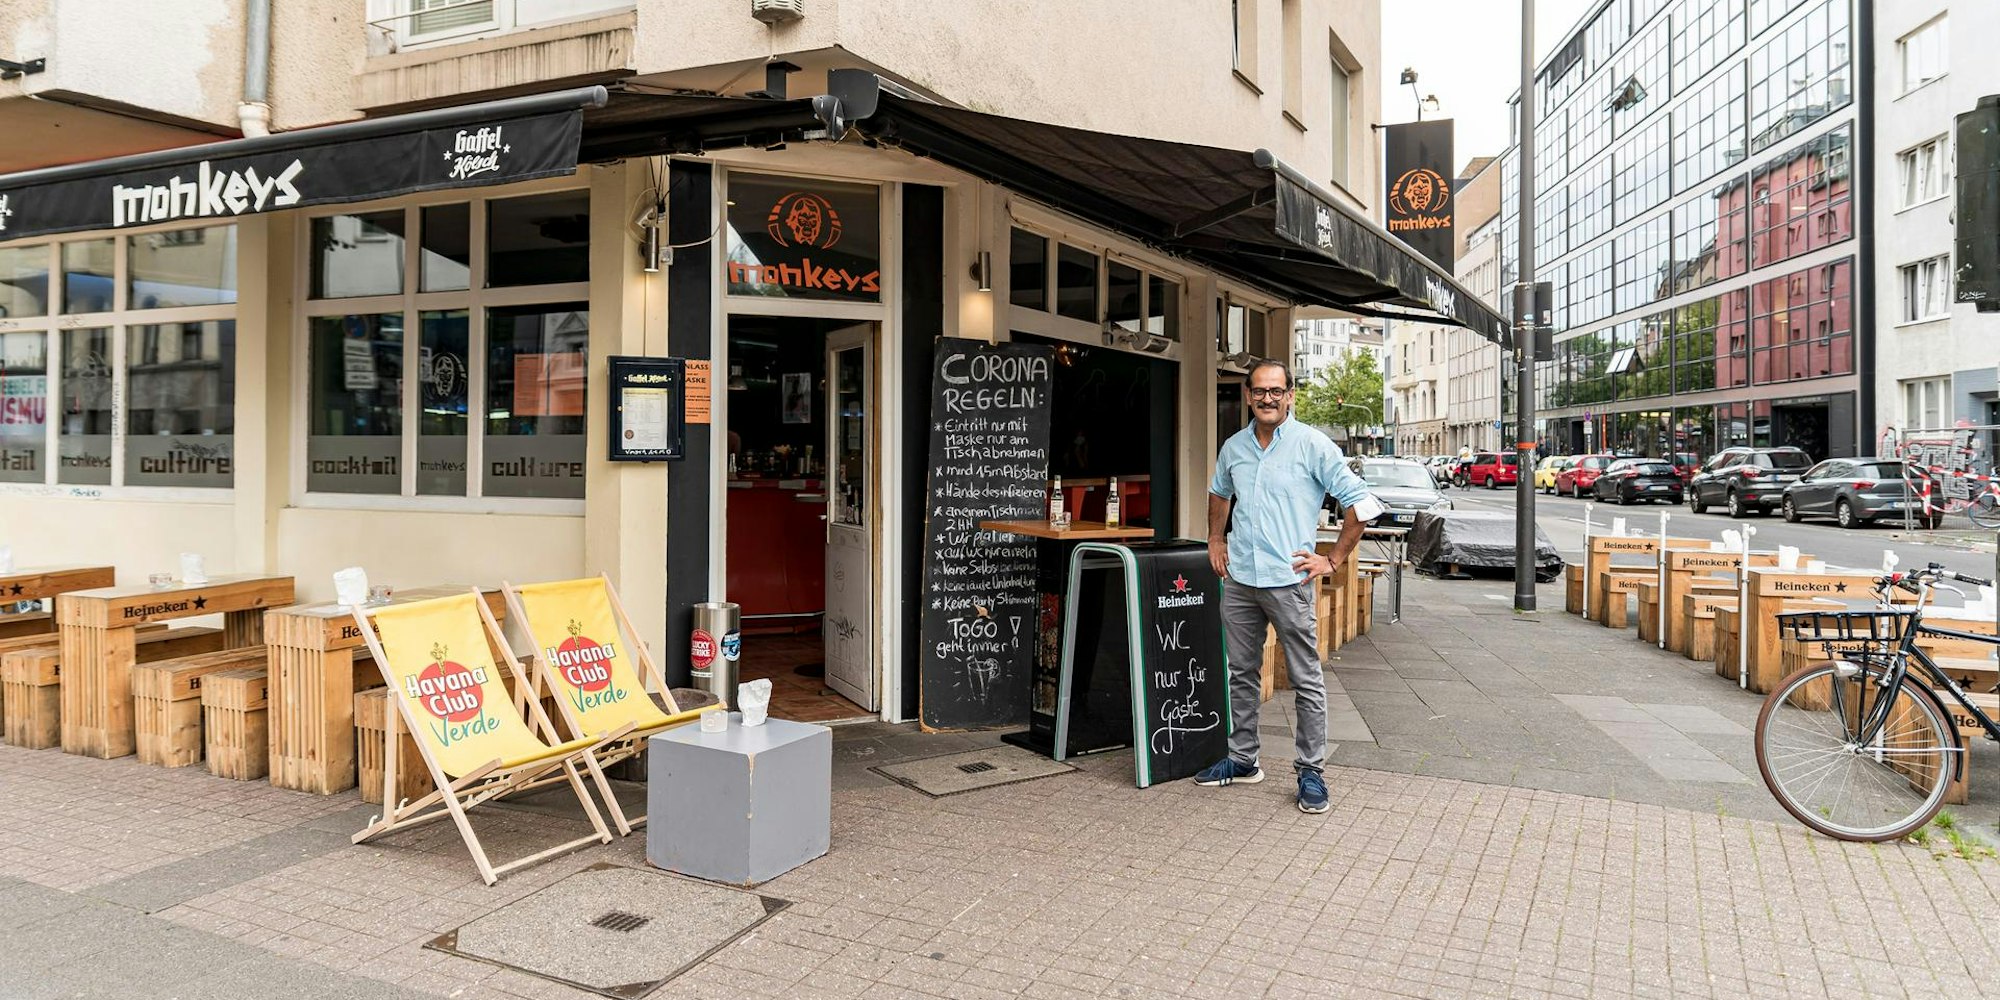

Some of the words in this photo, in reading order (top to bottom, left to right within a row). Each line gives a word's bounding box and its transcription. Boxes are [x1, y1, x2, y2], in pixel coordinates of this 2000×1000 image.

[454, 126, 502, 153] Gaffel
[449, 150, 500, 180] Kölsch
[113, 158, 303, 227] monkeys
[1389, 213, 1451, 231] monkeys
[729, 258, 880, 293] monkeys
[941, 353, 1048, 384] CORONA
[942, 386, 1044, 414] REGELN:
[945, 417, 987, 432] Eintritt
[991, 421, 1005, 431] nur
[1007, 416, 1028, 432] mit
[945, 433, 984, 446] Maske
[987, 435, 1007, 444] nur
[1009, 436, 1029, 445] am
[0, 451, 36, 471] tail
[140, 450, 230, 473] culture
[982, 446, 1045, 459] abnehmen
[312, 456, 397, 475] cocktail
[421, 457, 466, 472] monkeys
[492, 457, 584, 477] culture
[946, 479, 981, 499] Hände
[948, 531, 972, 545] Wir
[1604, 542, 1643, 550] Heineken
[1683, 557, 1728, 567] Heineken
[1774, 581, 1831, 592] Heineken
[124, 600, 189, 618] Heineken
[943, 595, 971, 611] Keine
[1158, 593, 1204, 609] Heineken
[1156, 620, 1190, 651] WC
[546, 643, 617, 668] Havana
[936, 637, 965, 659] geht
[967, 638, 1009, 653] immer
[405, 667, 489, 697] Havana
[566, 663, 609, 685] Club
[1155, 671, 1181, 689] nur
[1187, 657, 1207, 699] für
[429, 690, 479, 717] Club
[568, 680, 628, 713] Verde
[430, 708, 501, 747] Verde
